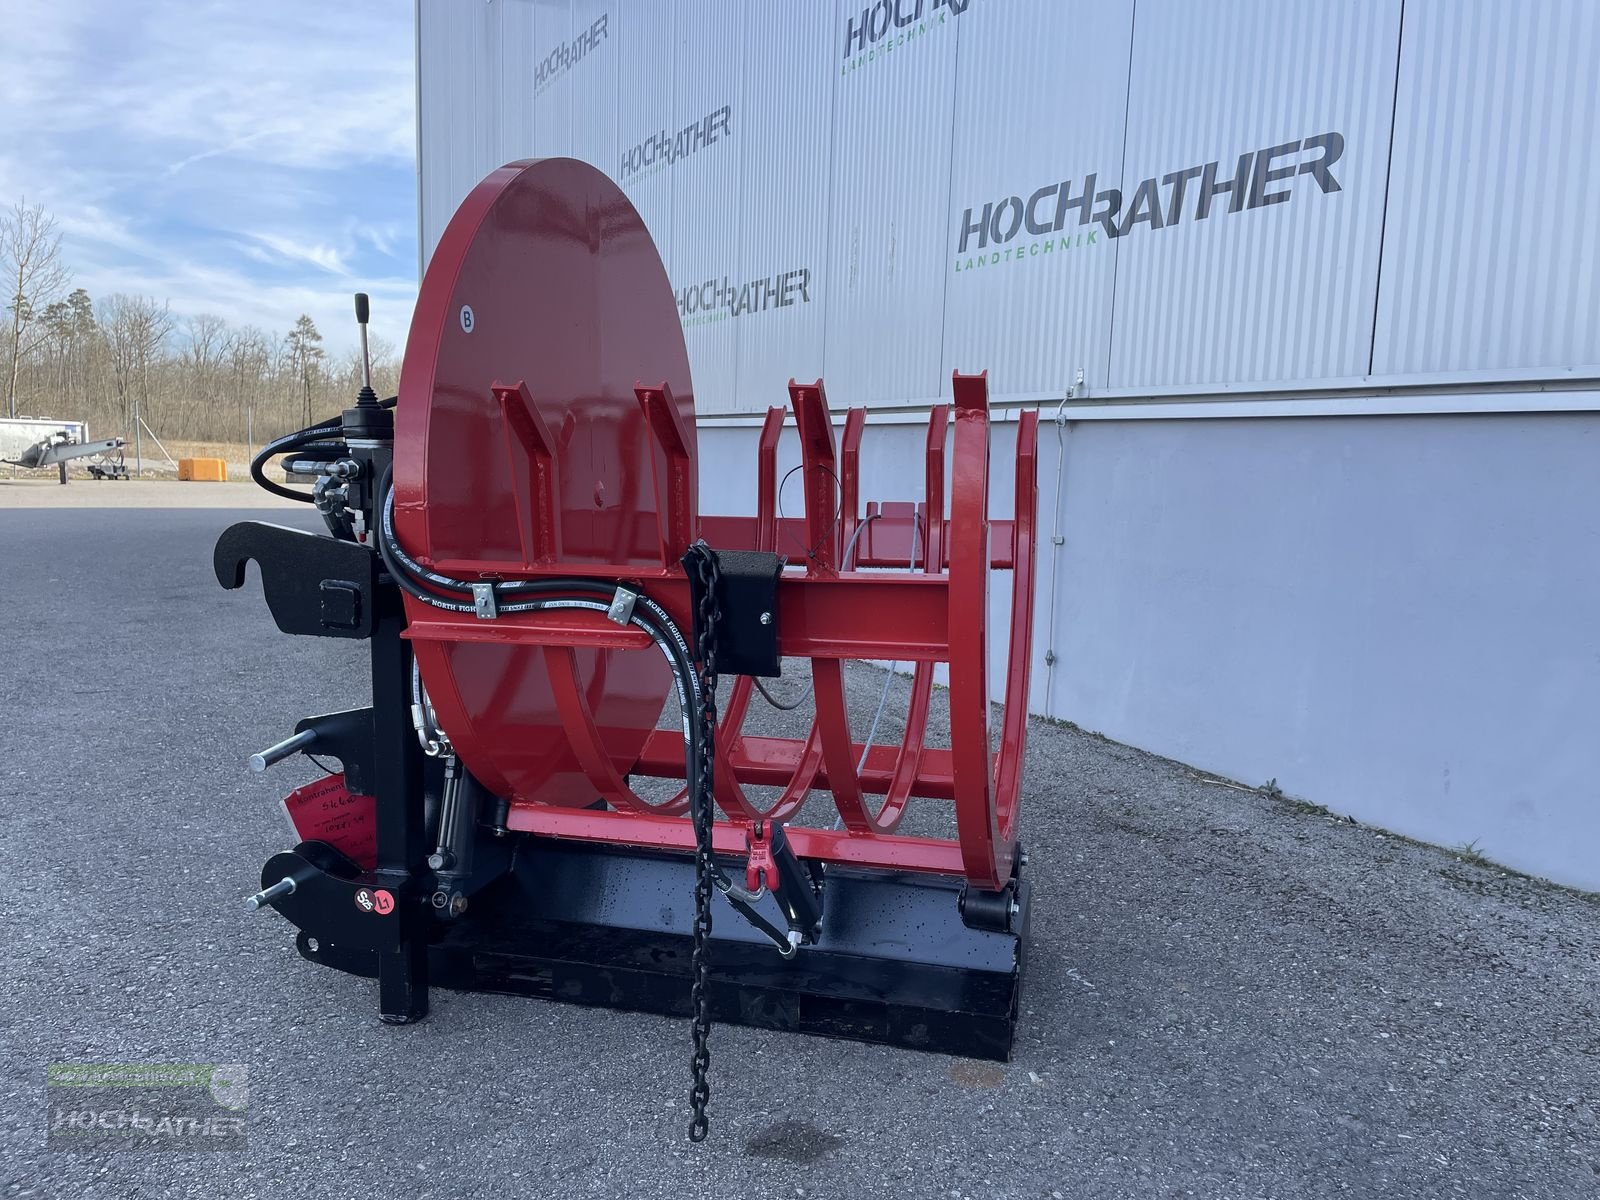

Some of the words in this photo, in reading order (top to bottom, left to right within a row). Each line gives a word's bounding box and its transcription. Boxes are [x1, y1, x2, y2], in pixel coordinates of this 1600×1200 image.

[534, 13, 607, 90] HOCHRATHER
[841, 11, 946, 77] LANDTECHNIK
[620, 104, 731, 181] HOCHRATHER
[957, 131, 1345, 253] HOCHRATHER
[955, 230, 1097, 272] LANDTECHNIK
[674, 267, 811, 317] HOCHRATHER
[463, 310, 472, 328] B
[431, 599, 457, 612] NORTH
[458, 604, 478, 613] FIGH
[645, 599, 670, 621] NORTH
[376, 896, 390, 910] L1
